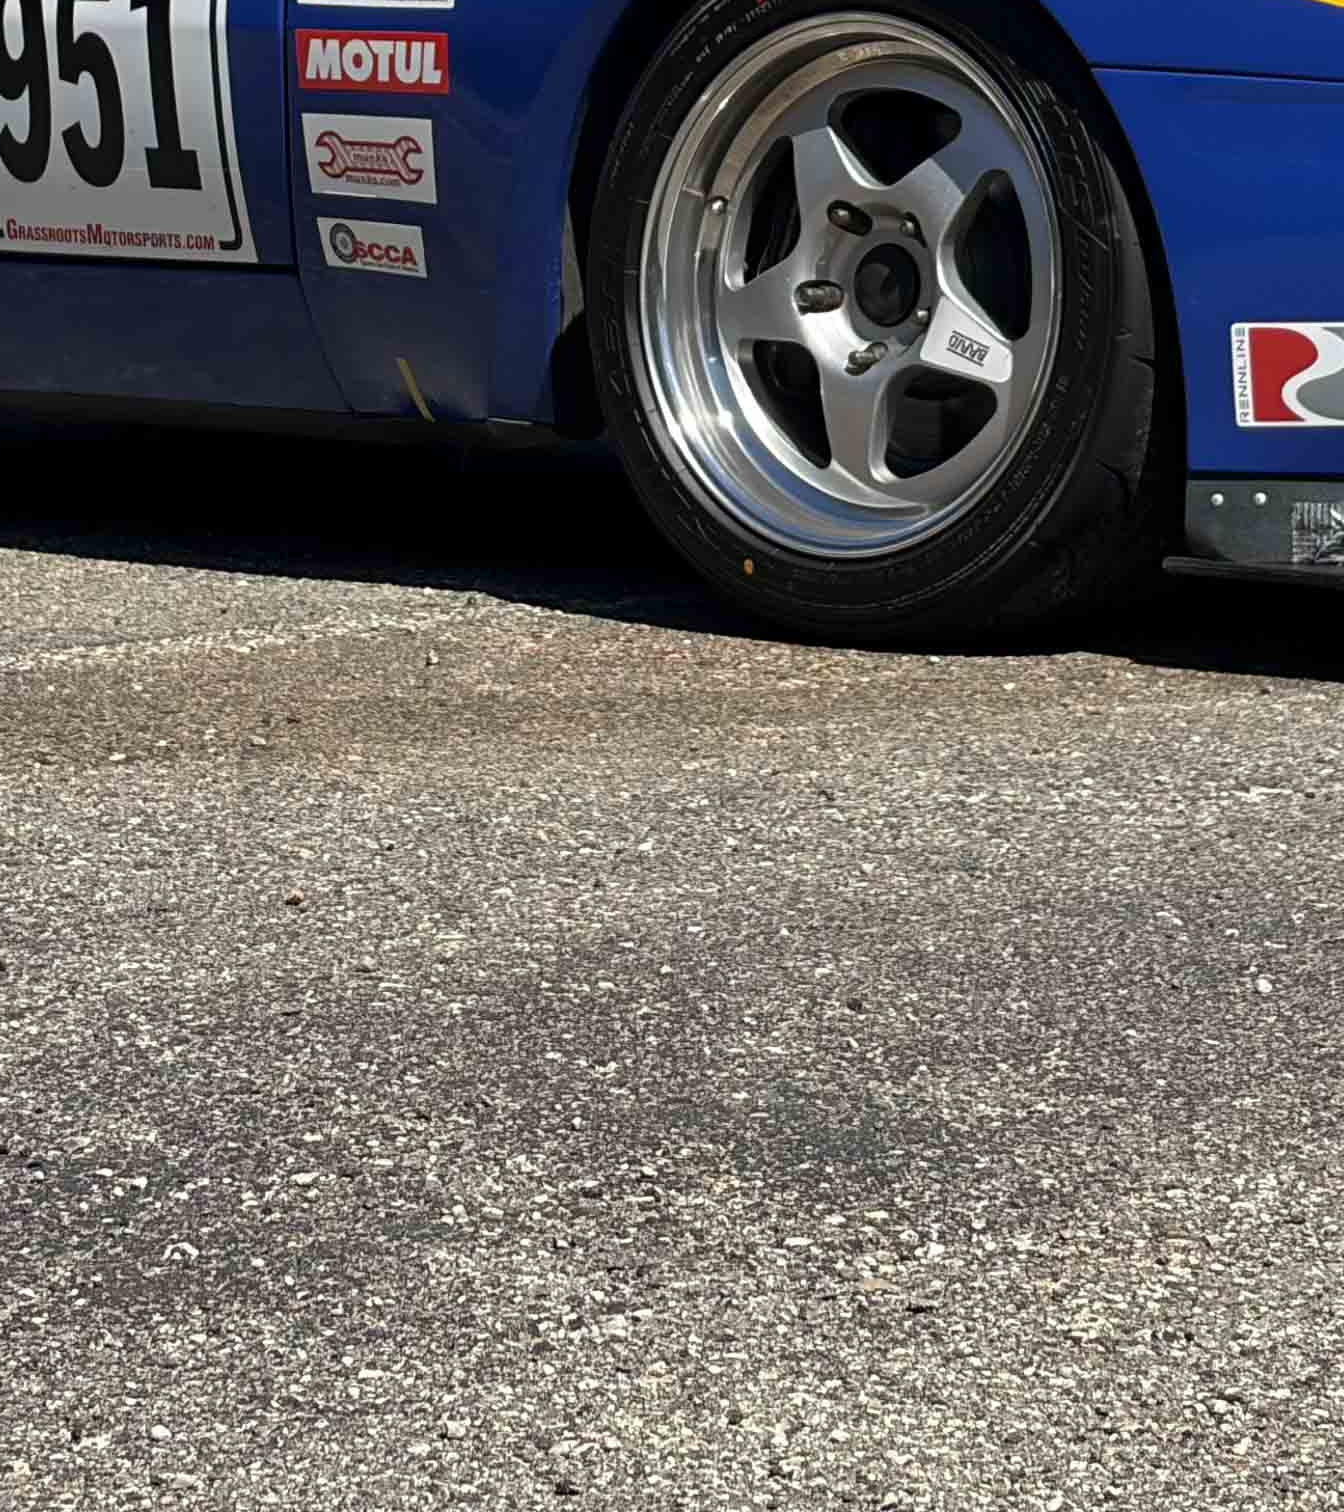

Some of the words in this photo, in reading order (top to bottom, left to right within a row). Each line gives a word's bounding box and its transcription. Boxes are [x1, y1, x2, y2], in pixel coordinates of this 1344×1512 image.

[306, 38, 442, 84] MOTUL
[353, 241, 417, 265] SCCA
[1234, 326, 1251, 424] RENNLINE
